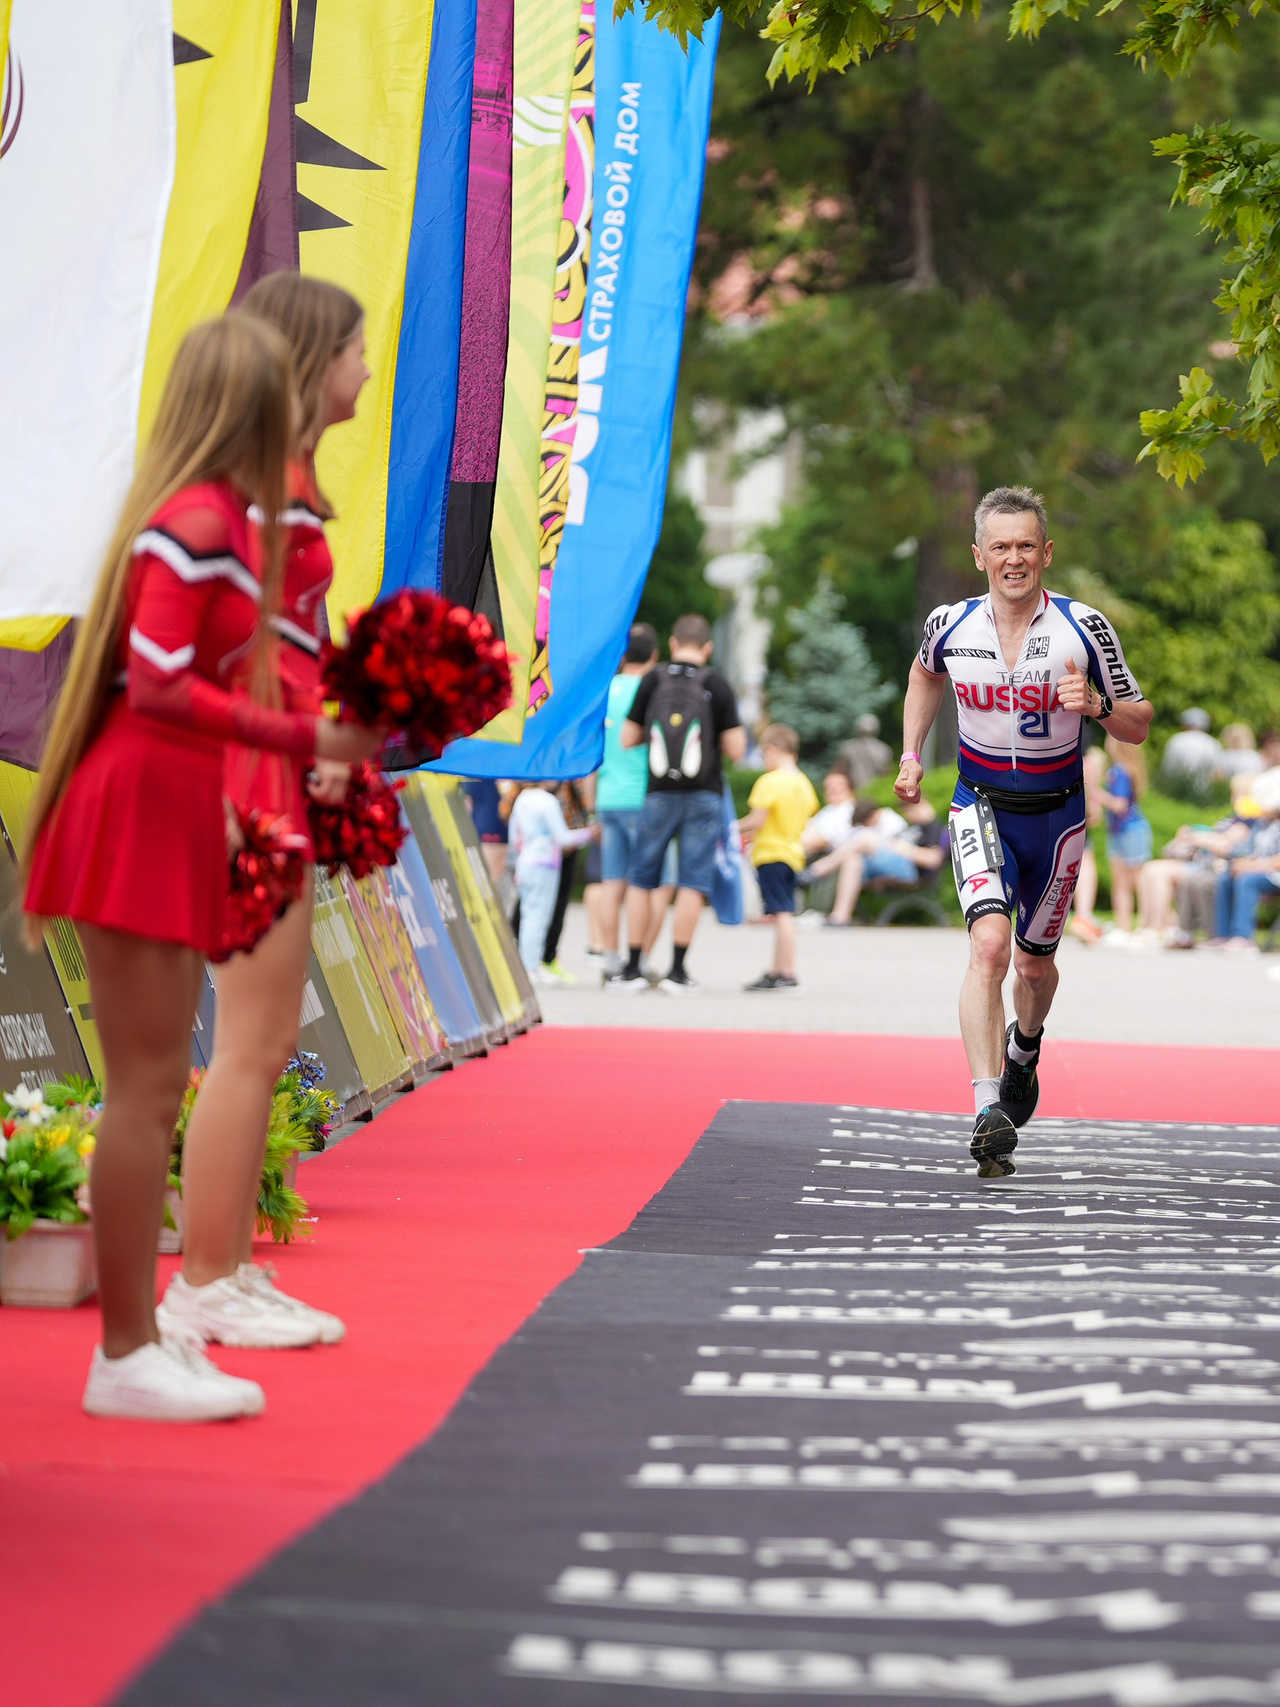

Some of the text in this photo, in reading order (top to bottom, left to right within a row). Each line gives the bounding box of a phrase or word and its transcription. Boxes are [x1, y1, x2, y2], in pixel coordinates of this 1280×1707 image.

[586, 160, 634, 342] СТРАХОВОЙ
[613, 81, 643, 156] ДОМ
[951, 649, 993, 659] CANYON
[996, 669, 1051, 683] TEAM
[954, 682, 1067, 713] RUSSIA
[960, 828, 979, 859] 411
[1042, 859, 1081, 940] RUSSIA
[1044, 877, 1064, 907] TEAM
[973, 902, 1004, 914] CANYON
[801, 1197, 1017, 1209] IRON
